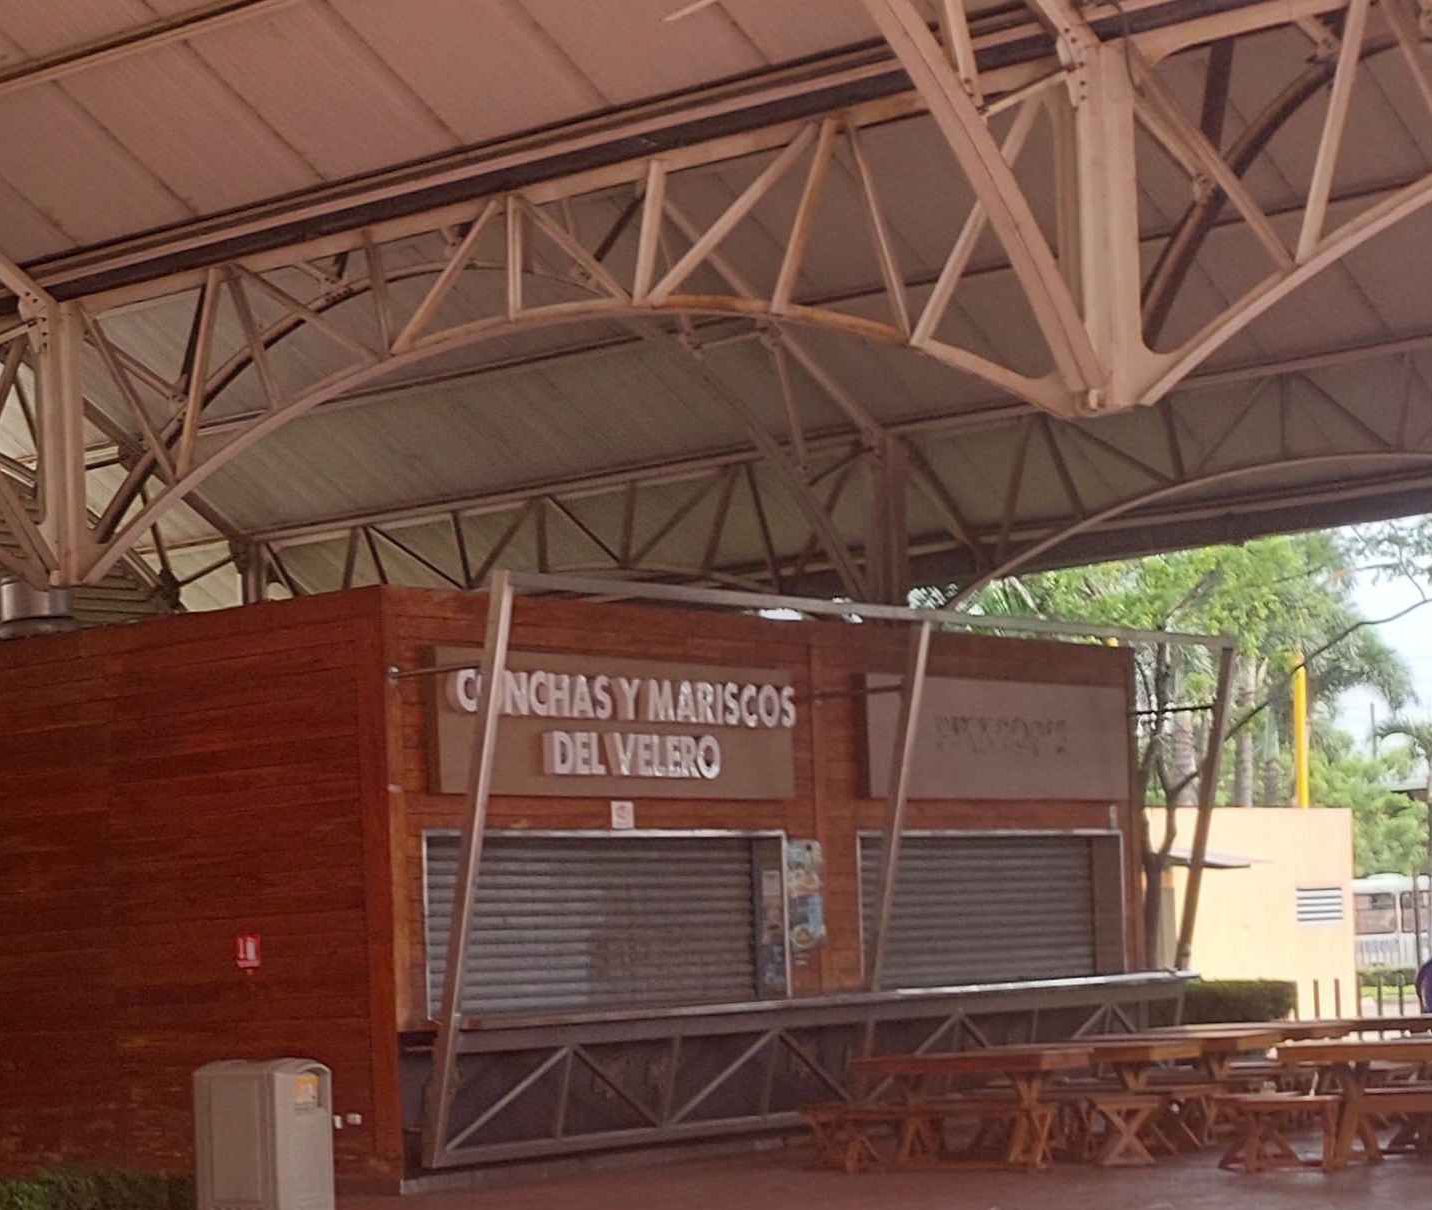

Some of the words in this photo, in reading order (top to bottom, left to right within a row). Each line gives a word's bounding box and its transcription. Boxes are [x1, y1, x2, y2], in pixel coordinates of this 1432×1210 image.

[447, 668, 612, 719] CNCHAS
[611, 677, 640, 720] Y
[648, 679, 796, 728] MARISCOS
[543, 731, 607, 775] DEL
[603, 732, 721, 779] VELERO
